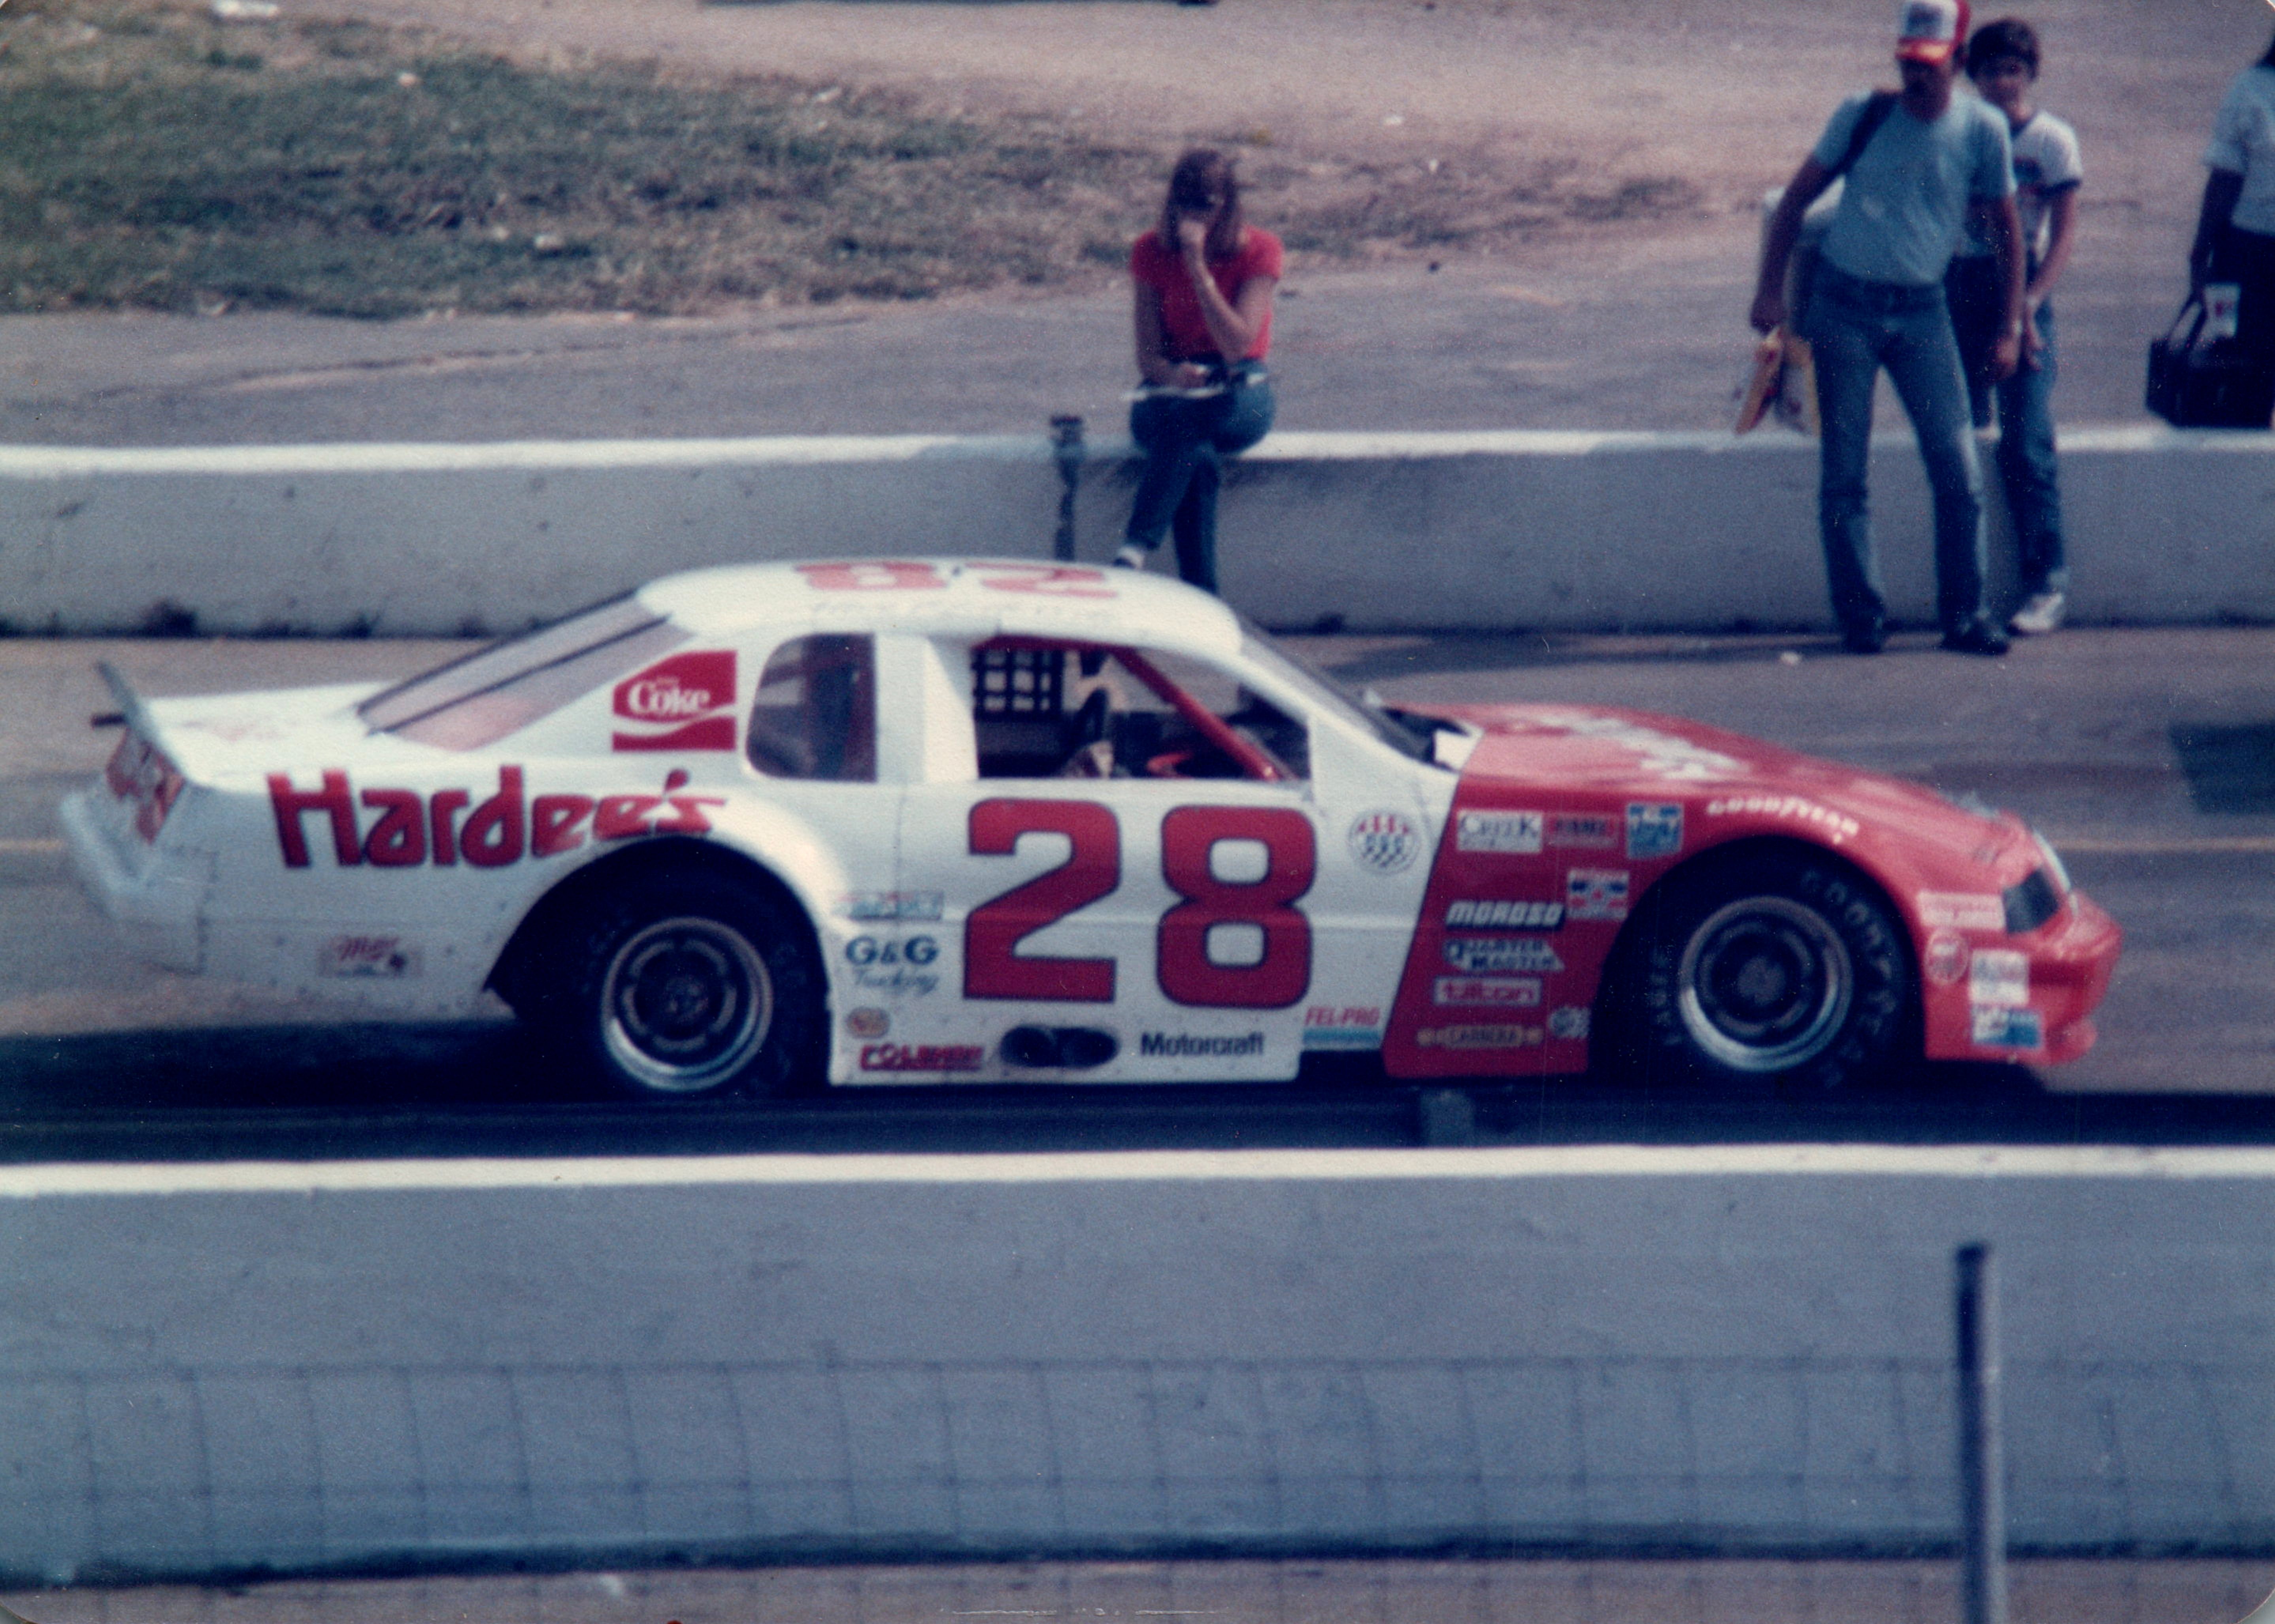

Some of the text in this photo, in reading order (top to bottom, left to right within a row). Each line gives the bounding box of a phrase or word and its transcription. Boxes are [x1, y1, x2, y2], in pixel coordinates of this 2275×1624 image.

[627, 679, 711, 715] Coke
[266, 764, 726, 868] Hardee's
[964, 797, 1316, 1009] 28
[1445, 899, 1565, 926] MOROSO
[1140, 1031, 1265, 1056] Motorcraft
